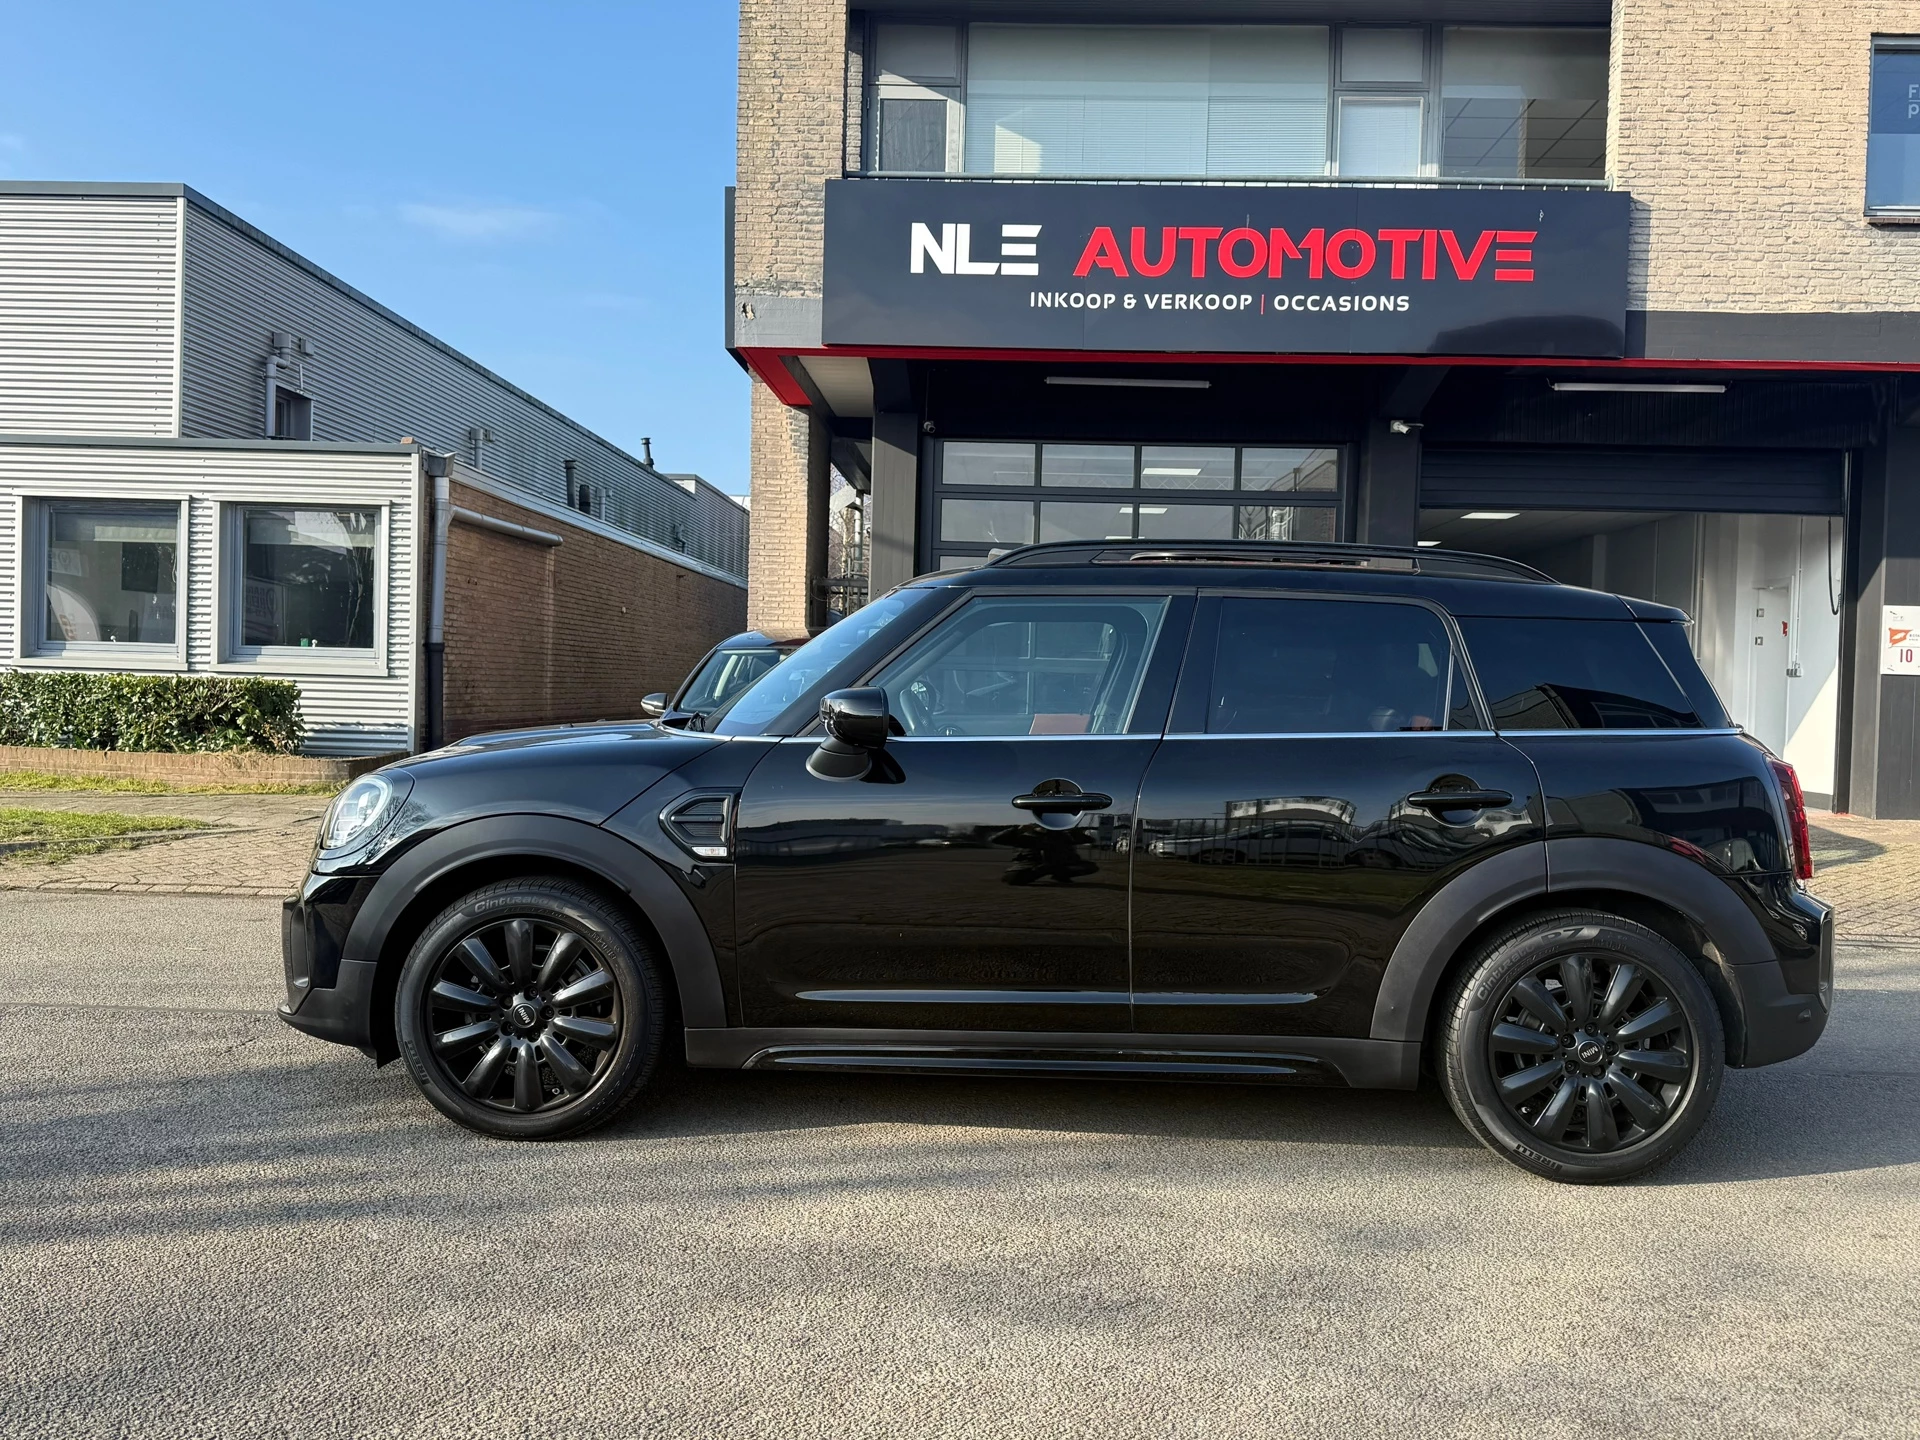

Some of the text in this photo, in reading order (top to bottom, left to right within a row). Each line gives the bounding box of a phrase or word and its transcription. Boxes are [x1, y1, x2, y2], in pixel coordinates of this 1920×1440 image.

[1908, 84, 1920, 98] F
[910, 222, 1538, 282] NLE AUTOMOTIVE
[1029, 291, 1116, 310] INKOOP
[1123, 293, 1138, 310] &
[1144, 293, 1253, 311] VERKOOP
[1273, 294, 1410, 312] OCCASIONS
[1900, 648, 1913, 663] 10
[474, 895, 550, 914] Cinturato
[1541, 926, 1585, 944] P7
